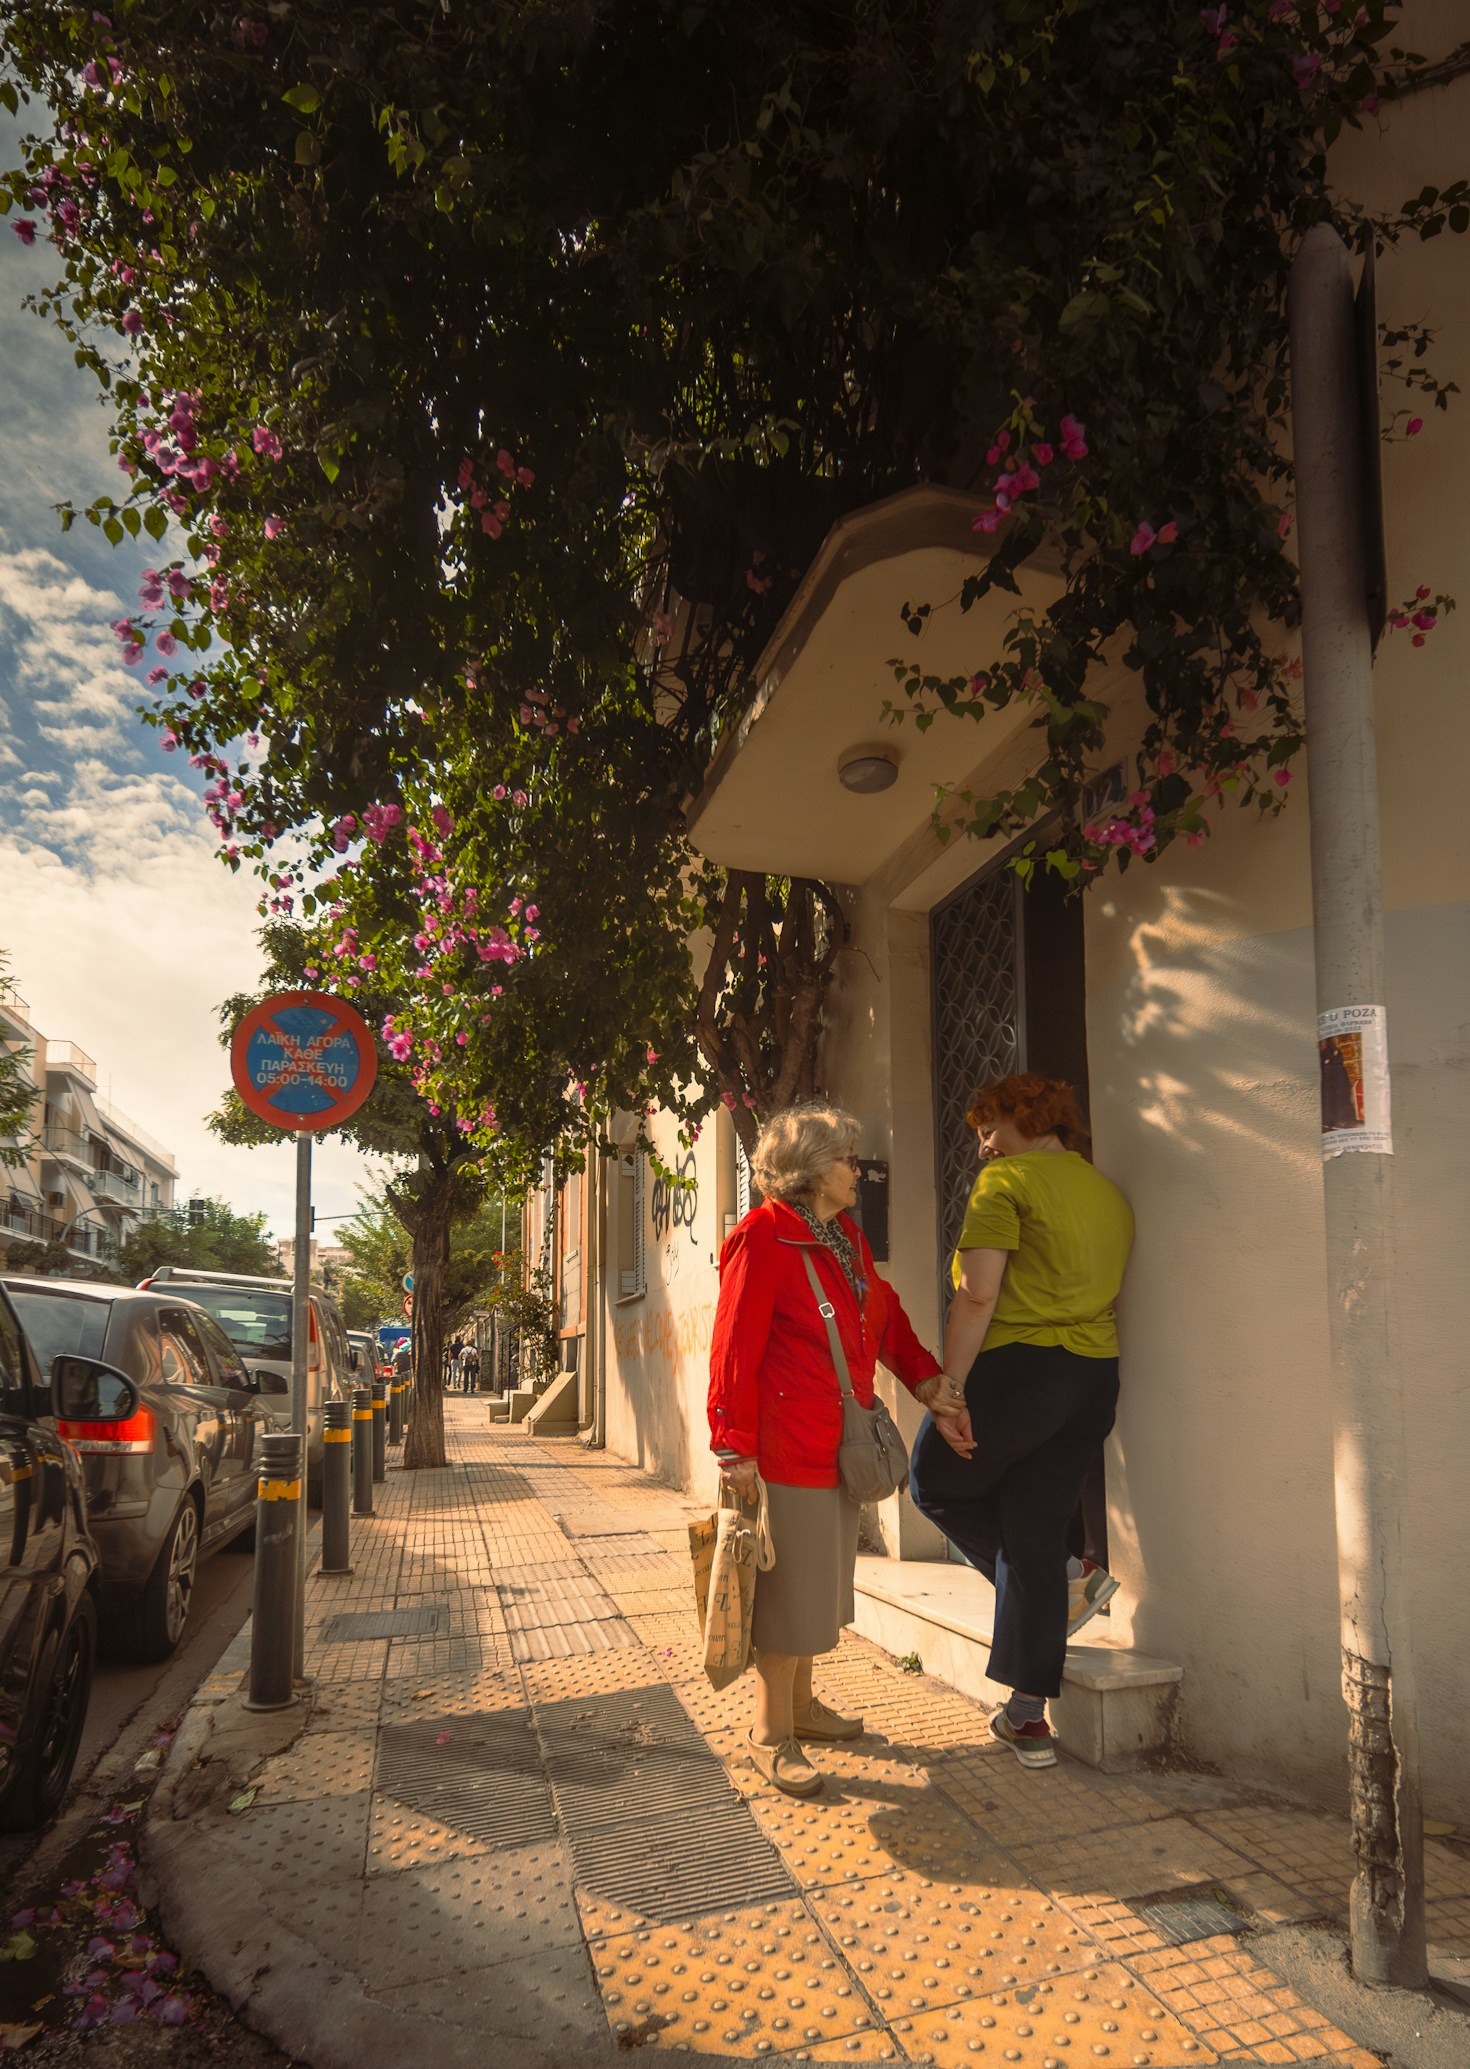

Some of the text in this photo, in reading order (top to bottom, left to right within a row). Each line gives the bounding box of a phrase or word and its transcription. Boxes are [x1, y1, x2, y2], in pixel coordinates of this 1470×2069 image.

[1343, 1008, 1377, 1019] POZA
[256, 1032, 350, 1049] ΛΑΪΚΗ ΑΓΟΡΑ
[284, 1047, 324, 1060] ΚΑΘΕ
[261, 1059, 345, 1074] ΠΑΡΑΣΚΕΥΗ
